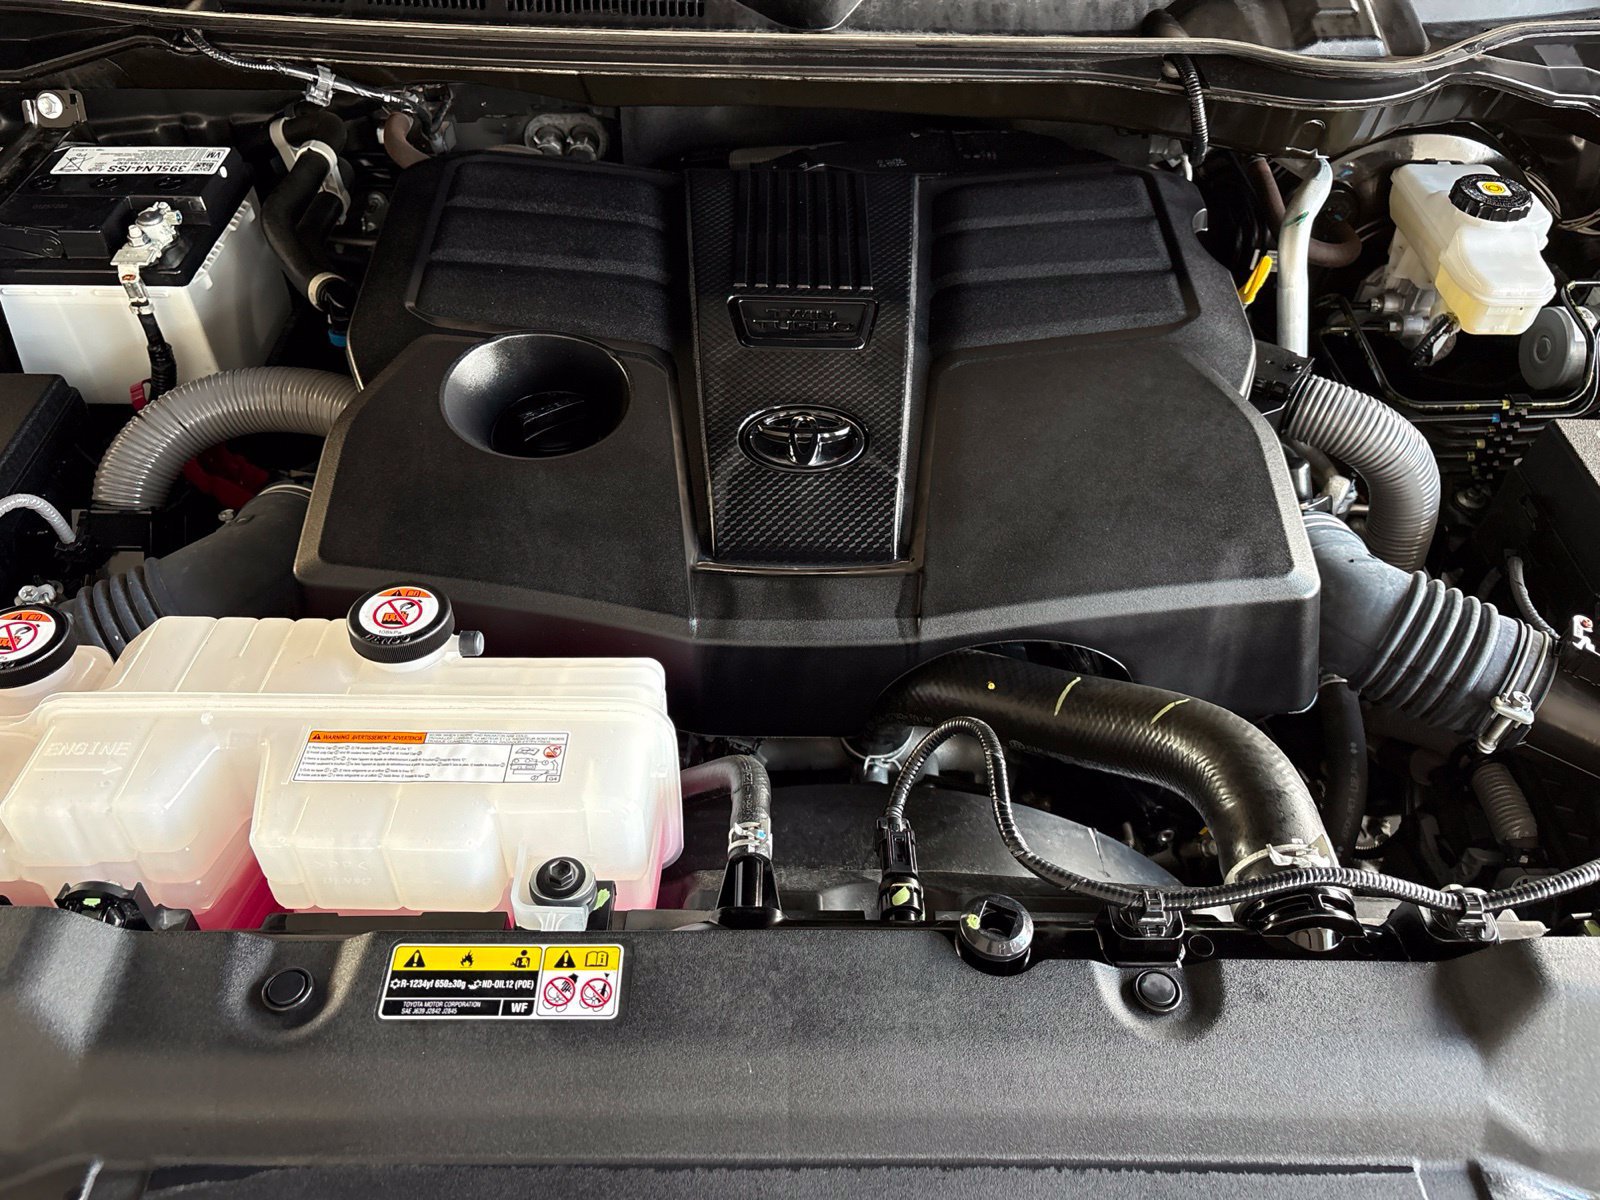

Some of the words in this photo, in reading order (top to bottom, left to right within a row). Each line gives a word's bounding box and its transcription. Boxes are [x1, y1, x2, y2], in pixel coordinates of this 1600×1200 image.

[107, 164, 187, 173] 395LN4-ISS
[44, 742, 132, 756] ENGINE
[401, 980, 434, 989] R-1234yf
[514, 980, 534, 990] (POE)
[511, 1003, 528, 1013] WF
